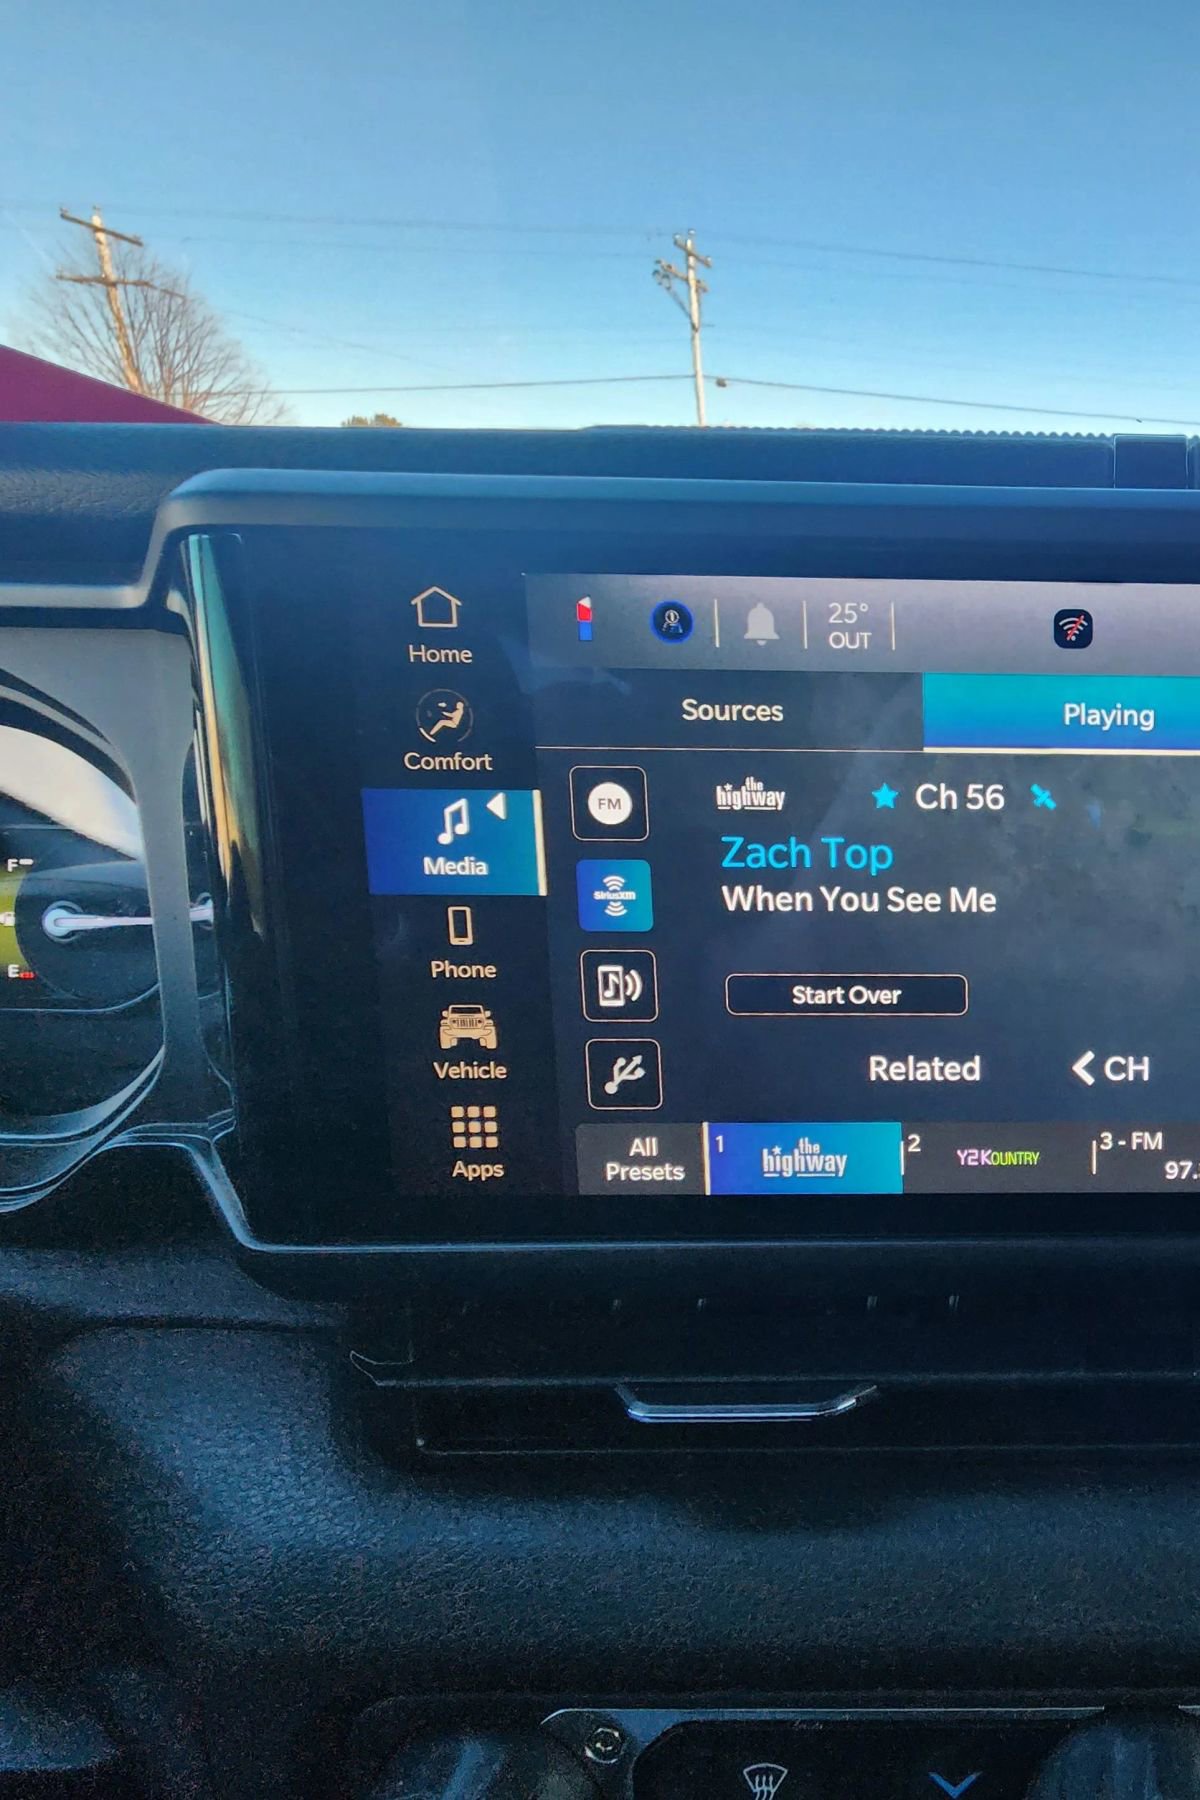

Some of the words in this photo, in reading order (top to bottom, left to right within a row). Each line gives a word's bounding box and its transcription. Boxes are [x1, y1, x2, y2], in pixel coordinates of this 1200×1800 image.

[828, 632, 872, 650] OUT
[408, 644, 473, 664] Home
[681, 699, 784, 722] Sources
[1063, 703, 1156, 731] Playing
[403, 752, 493, 772] Comfort
[745, 776, 764, 791] the
[597, 798, 622, 810] FM
[716, 785, 786, 811] highway
[915, 783, 958, 810] Ch
[966, 784, 1005, 810] 56
[7, 858, 19, 872] F
[721, 836, 812, 868] Zach
[821, 838, 894, 875] Top
[422, 856, 488, 876] Media
[721, 885, 814, 912] When
[819, 886, 880, 912] You
[886, 887, 943, 912] See
[949, 888, 997, 912] Me
[7, 964, 20, 978] E
[431, 960, 497, 980] Phone
[792, 986, 844, 1005] Start
[848, 986, 903, 1005] Over
[433, 1061, 508, 1080] Vehicle
[868, 1056, 982, 1082] Related
[1104, 1057, 1150, 1082] CH
[629, 1138, 658, 1156] All
[715, 1135, 724, 1153] 1
[798, 1137, 820, 1154] the
[907, 1134, 921, 1152] 2
[1100, 1131, 1113, 1150] 3
[1131, 1131, 1163, 1150] FM
[452, 1161, 505, 1181] Apps
[606, 1163, 685, 1182] Presets
[762, 1148, 848, 1178] highway
